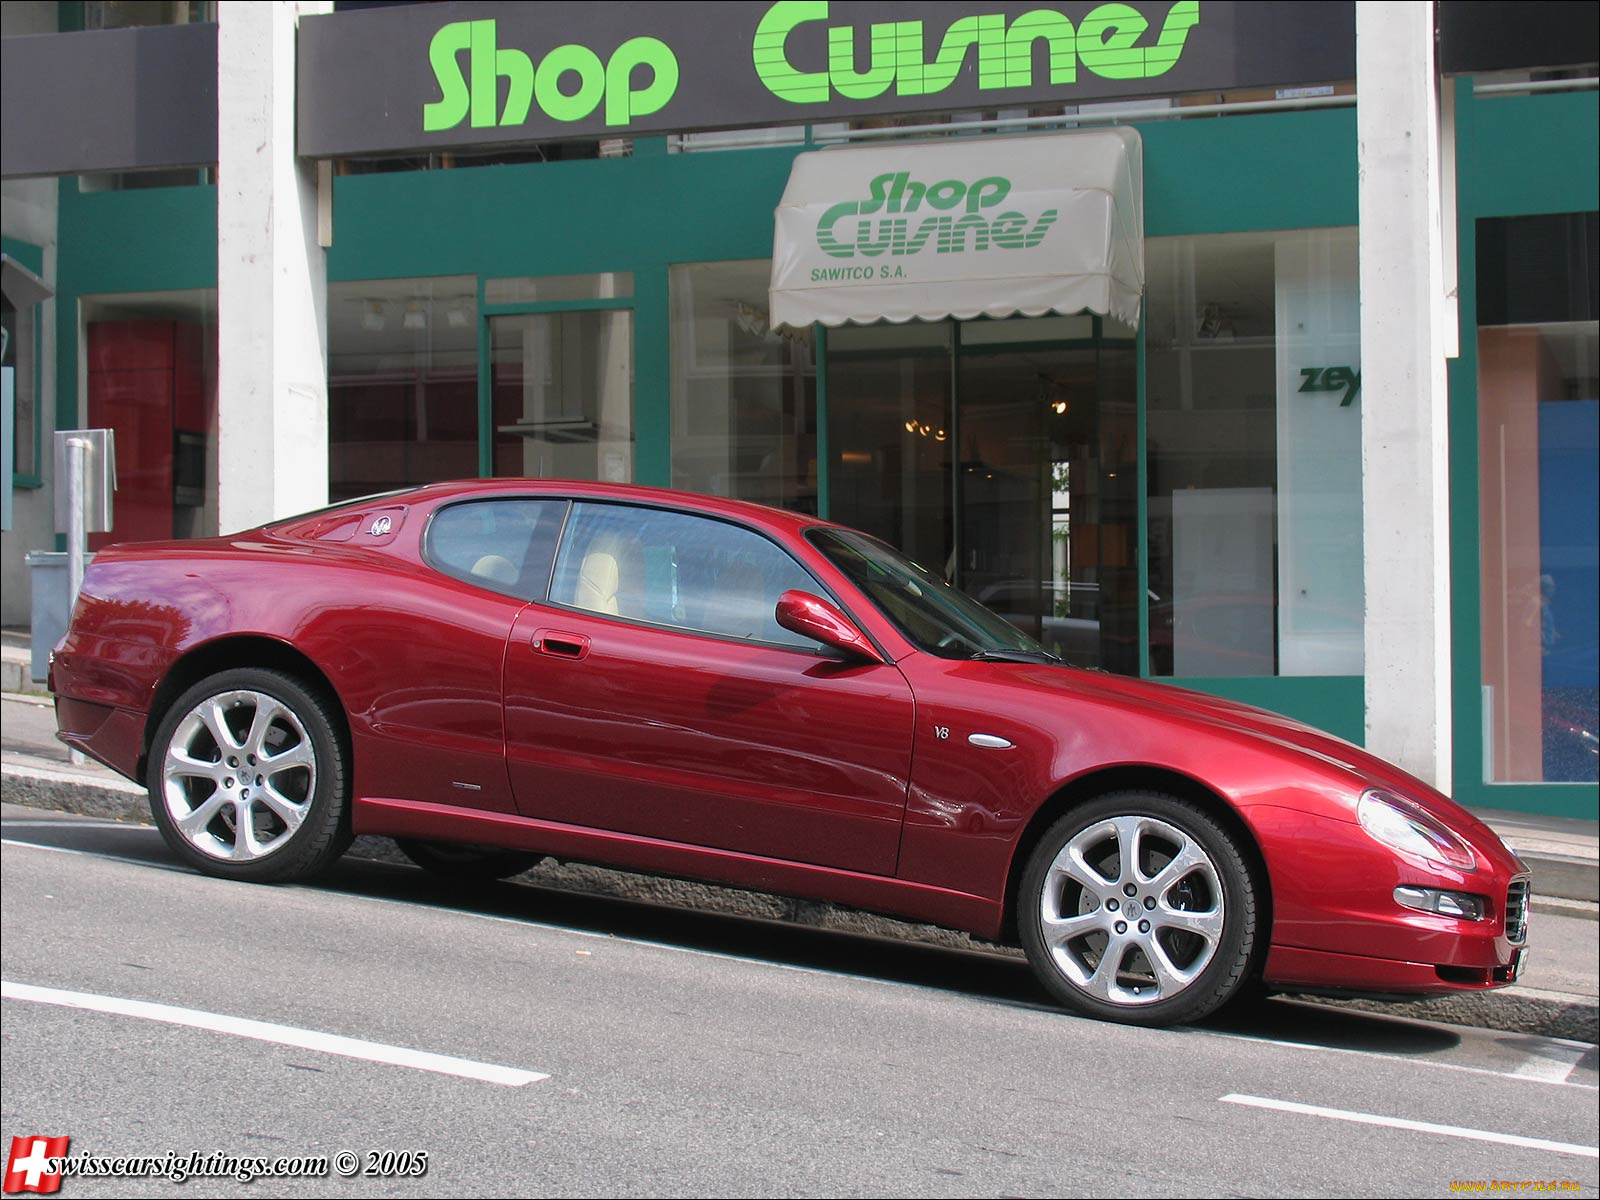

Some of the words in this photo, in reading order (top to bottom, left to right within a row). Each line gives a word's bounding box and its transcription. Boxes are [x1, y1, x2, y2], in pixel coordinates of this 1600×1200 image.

[424, 20, 679, 131] Shop
[753, 1, 1200, 103] Cuisines
[859, 171, 1012, 214] Shop
[816, 201, 1058, 258] Cuisines
[810, 266, 874, 282] SAWITCO
[880, 265, 907, 279] S.A.
[934, 725, 950, 740] V8
